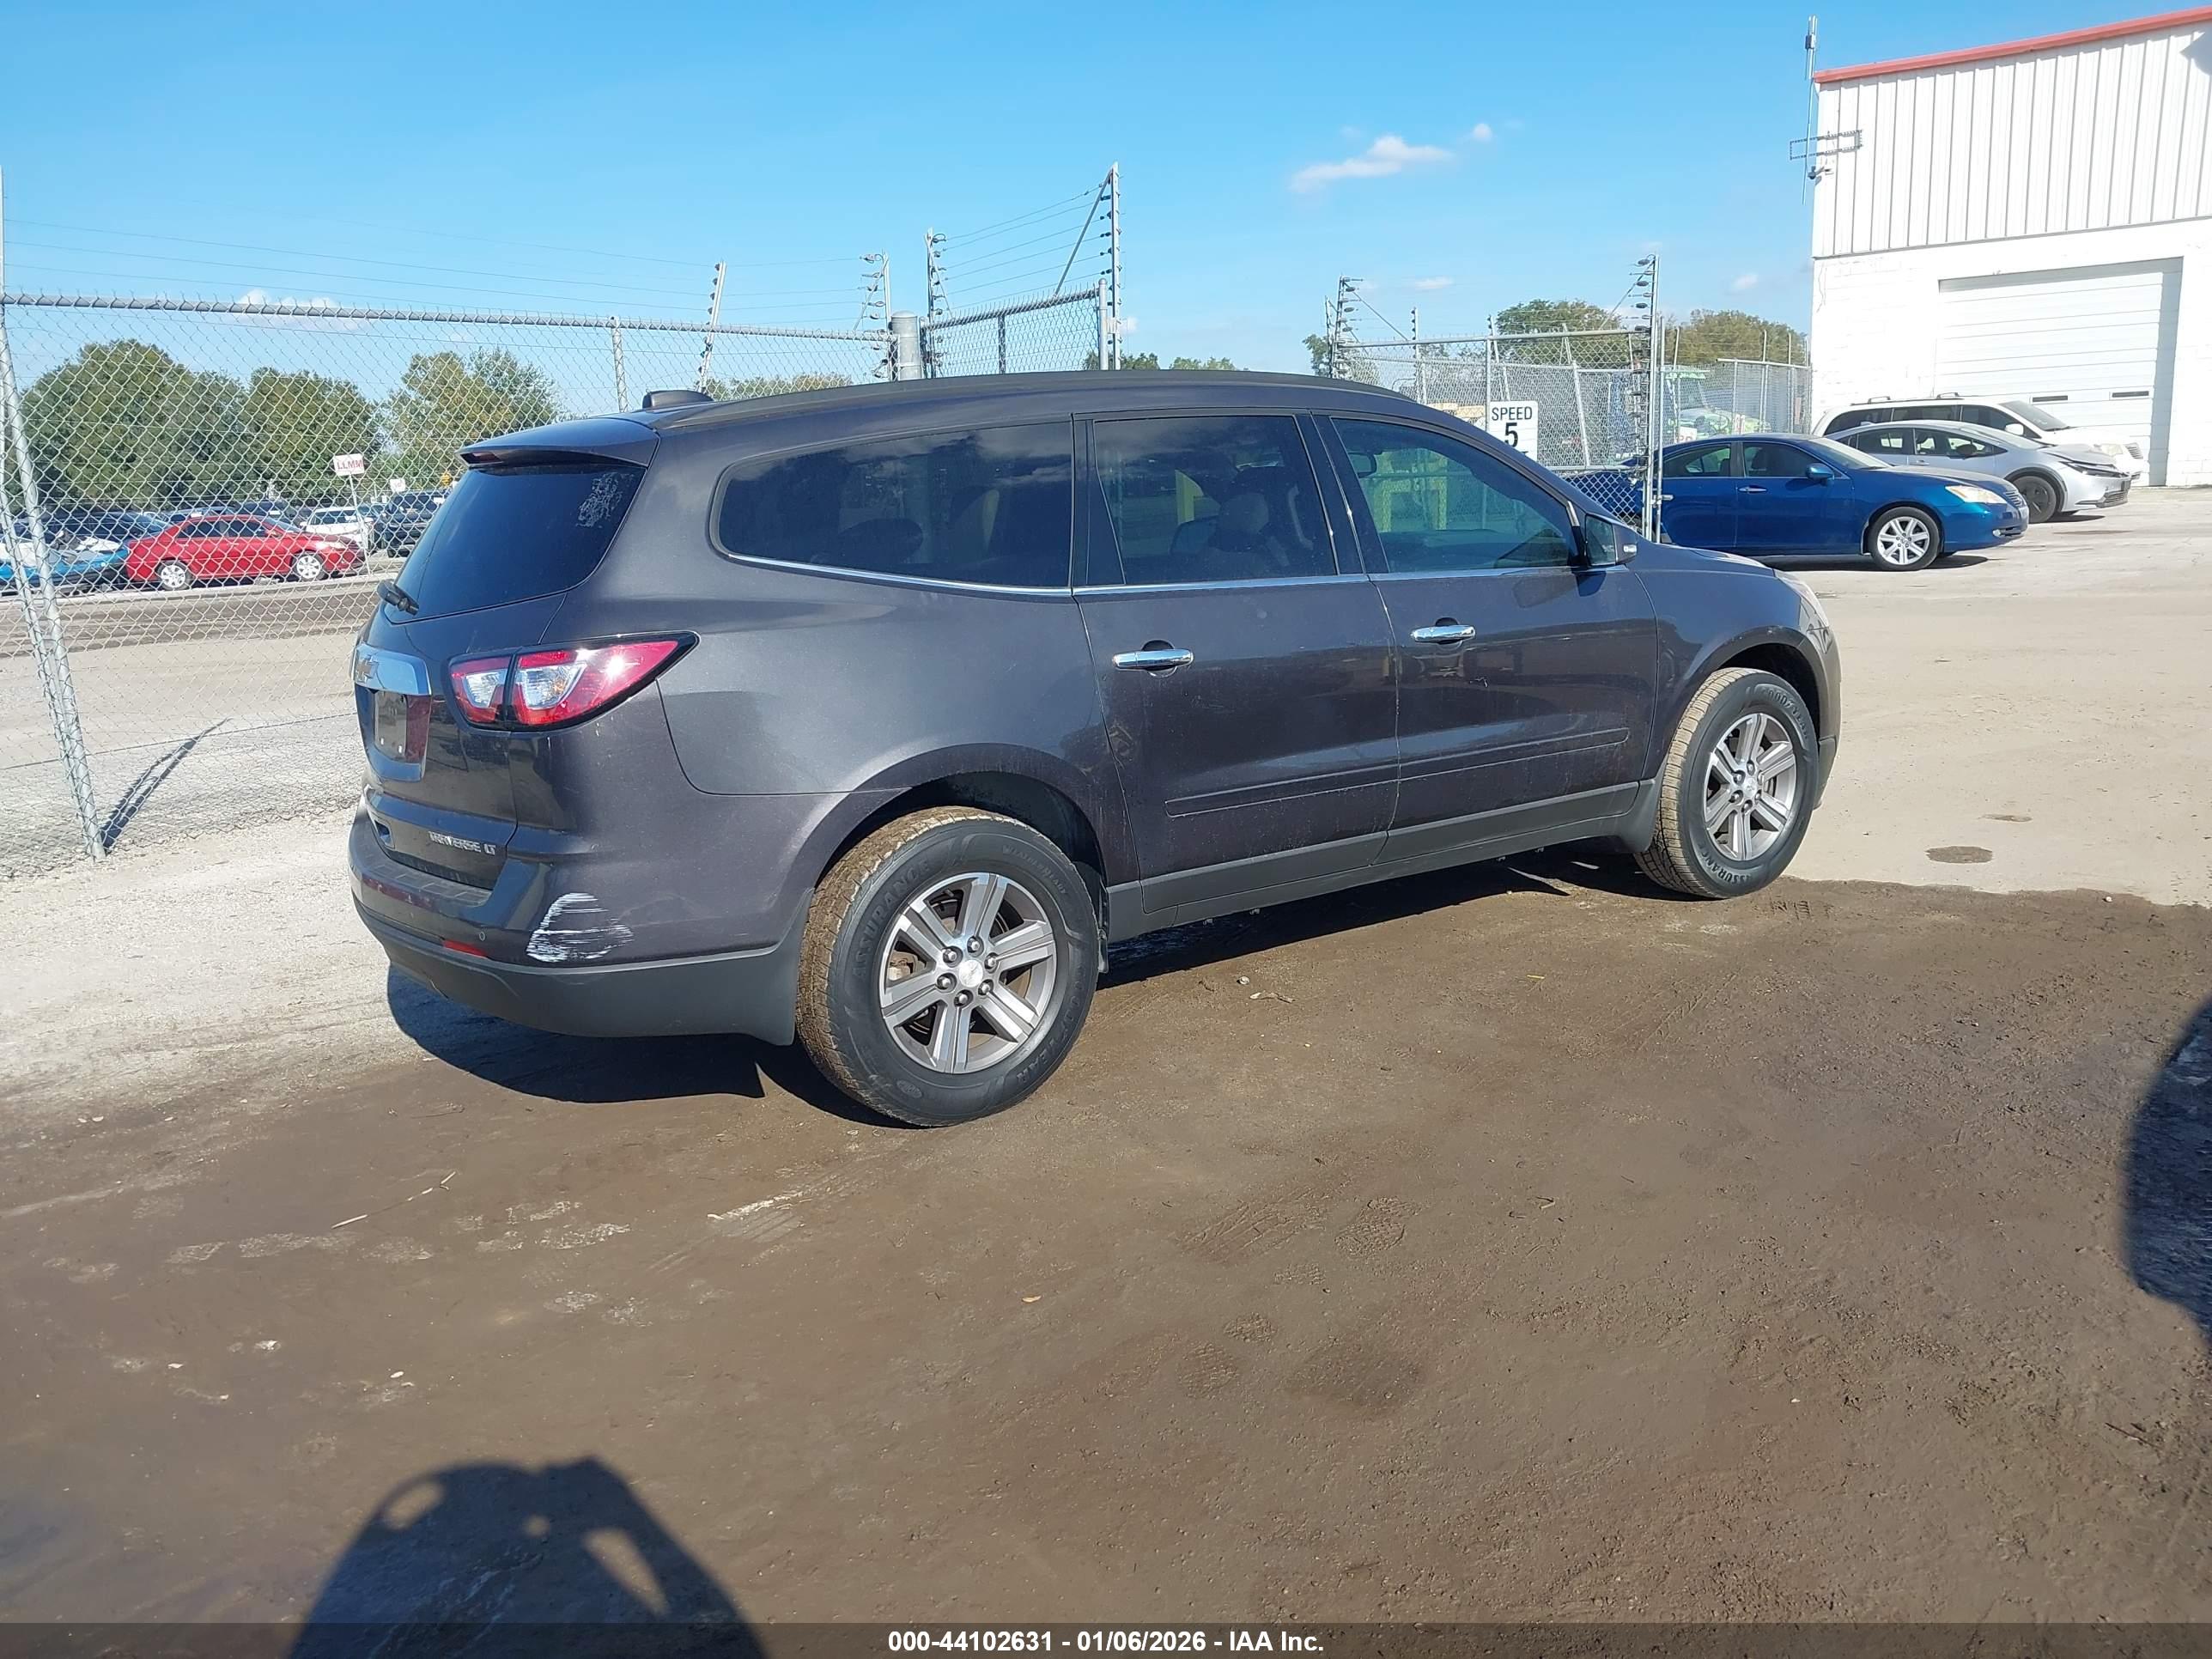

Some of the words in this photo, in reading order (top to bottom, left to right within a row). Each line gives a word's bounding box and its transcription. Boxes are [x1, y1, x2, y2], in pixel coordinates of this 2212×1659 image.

[1492, 406, 1533, 421] SPEED
[1504, 422, 1518, 447] 5
[483, 843, 496, 856] LT
